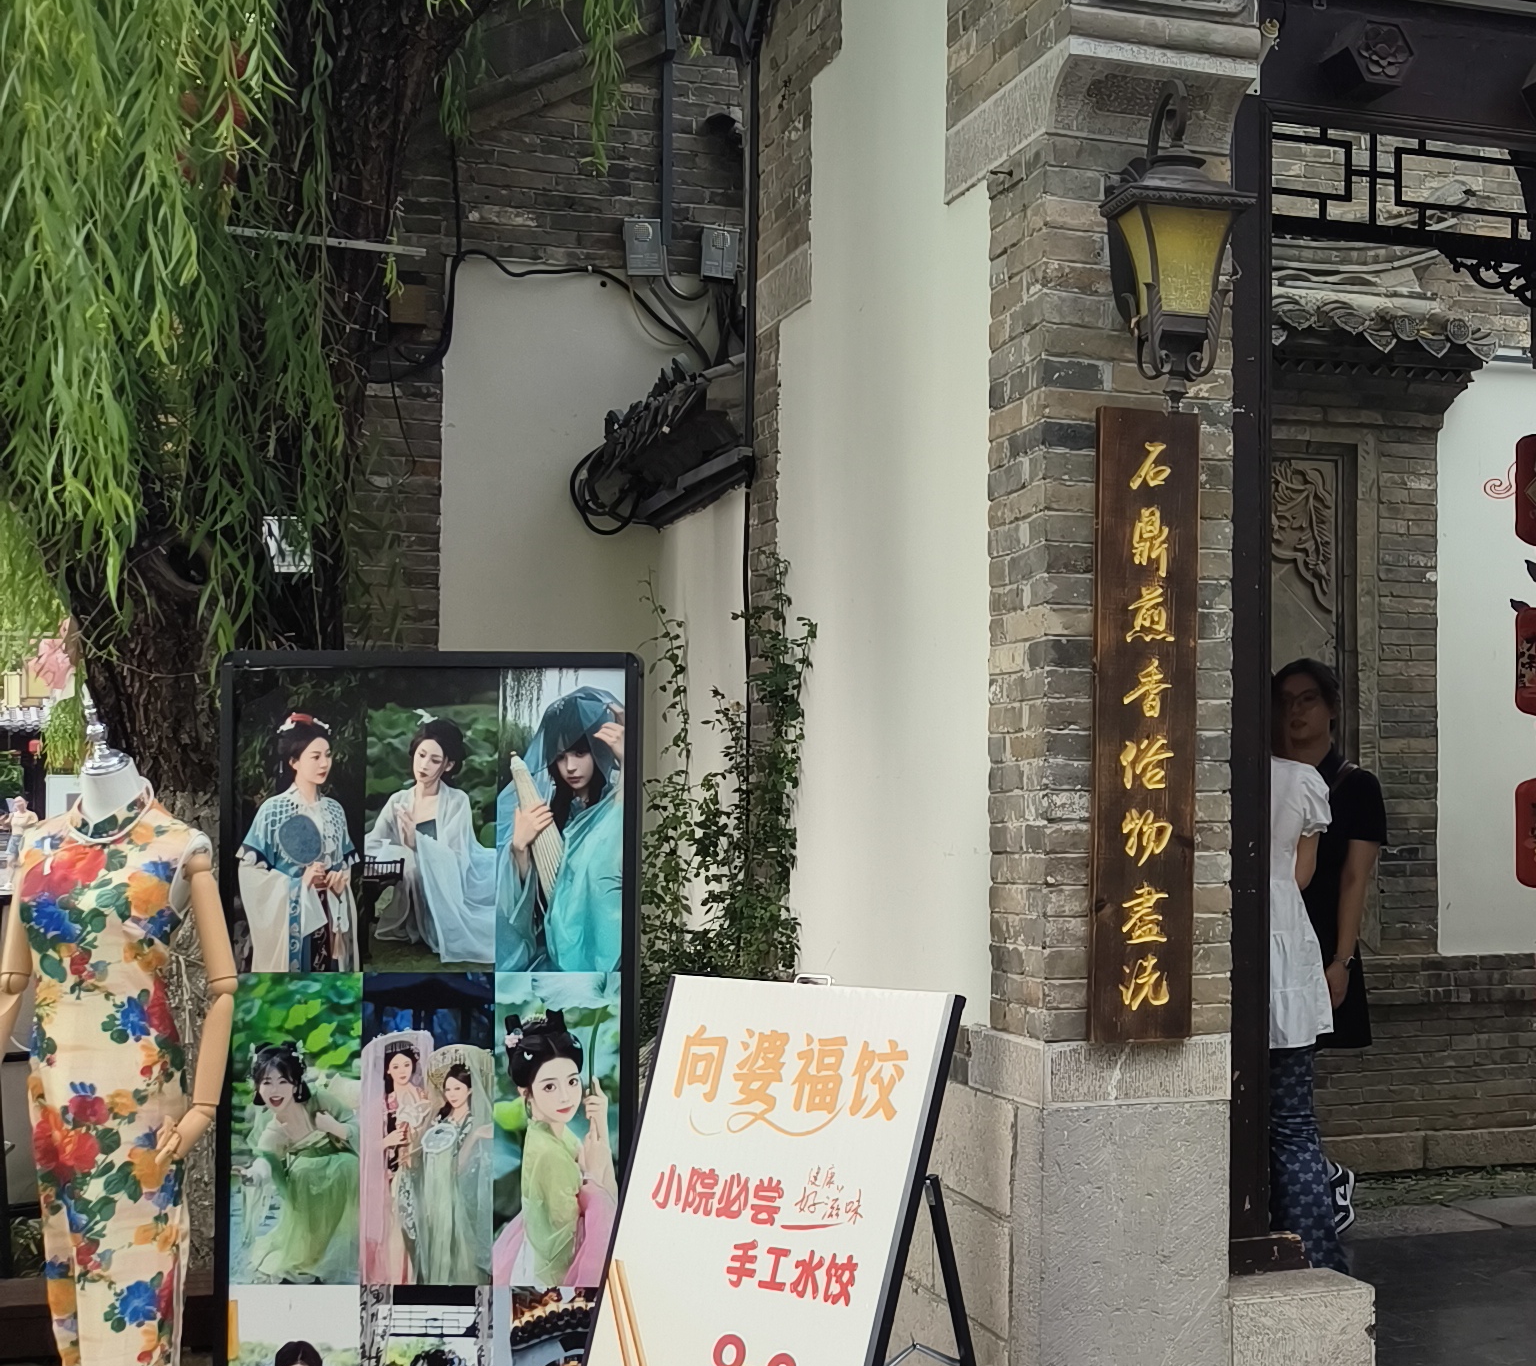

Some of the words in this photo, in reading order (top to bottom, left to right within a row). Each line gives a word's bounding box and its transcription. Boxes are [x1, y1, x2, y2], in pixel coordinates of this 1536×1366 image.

[673, 1024, 909, 1123] 向婆福饺
[651, 1164, 785, 1227] 小院必尝
[794, 1186, 864, 1225] 好滋味
[726, 1239, 859, 1307] 手工水饺
